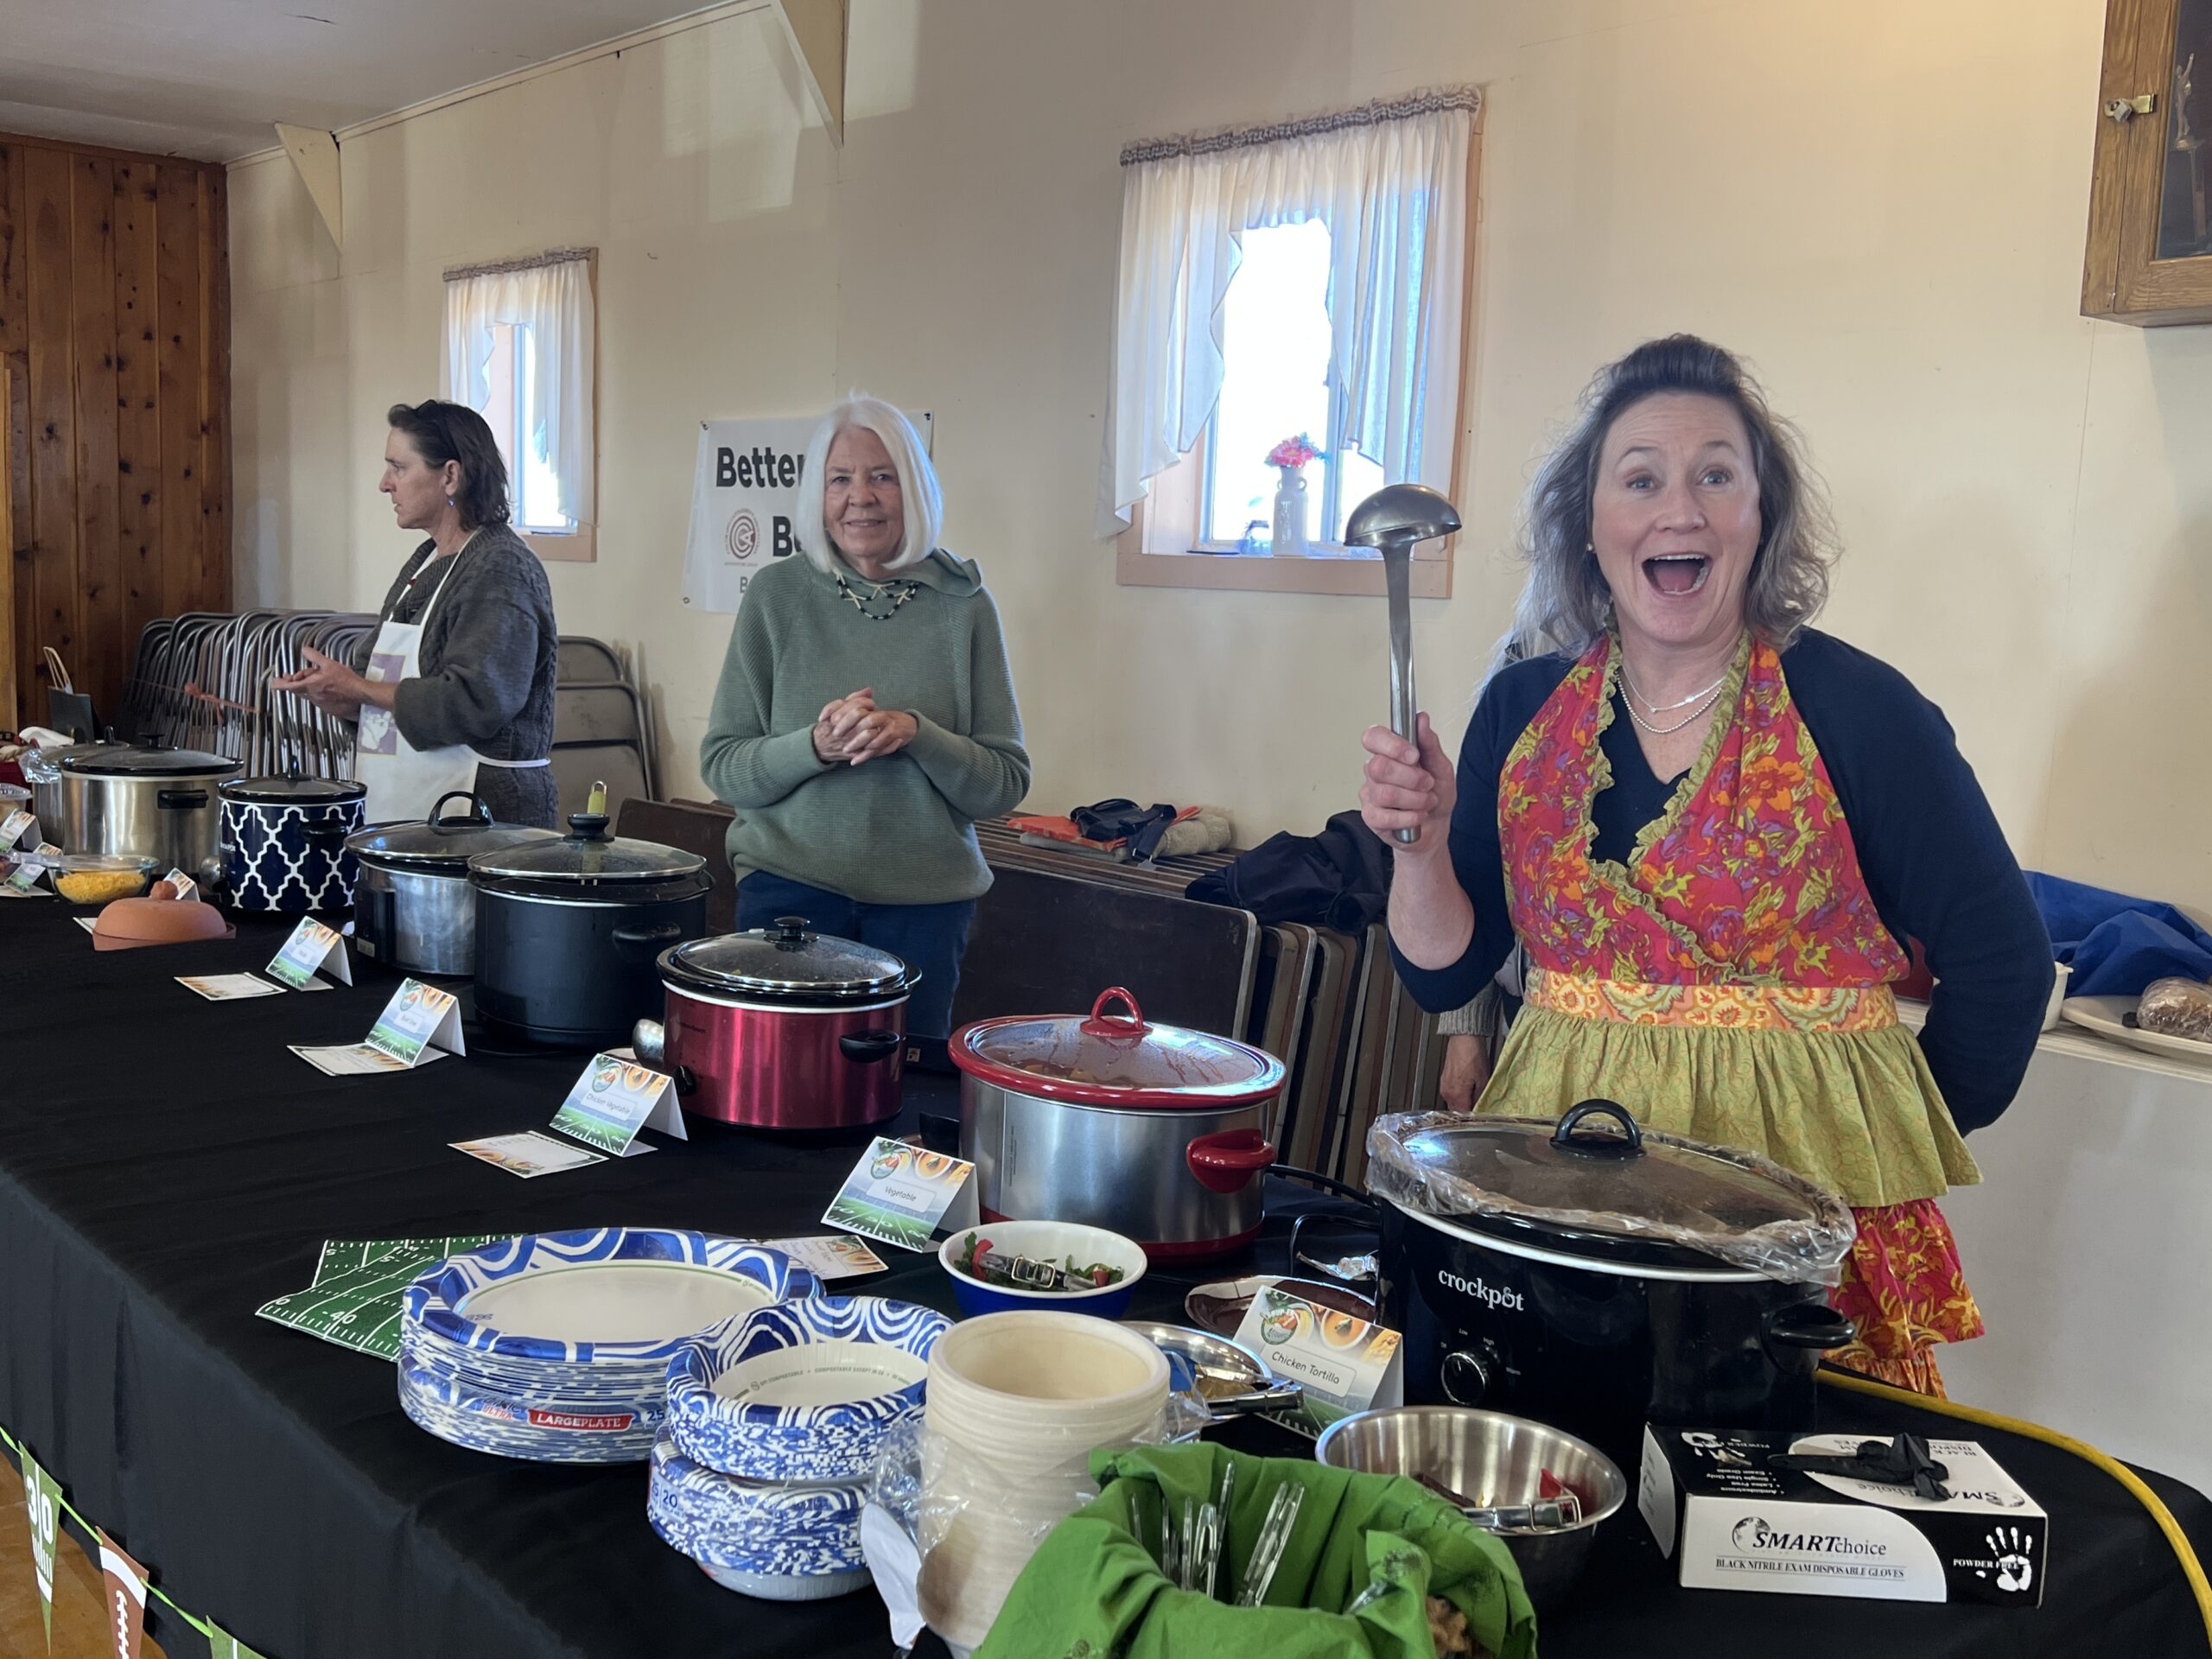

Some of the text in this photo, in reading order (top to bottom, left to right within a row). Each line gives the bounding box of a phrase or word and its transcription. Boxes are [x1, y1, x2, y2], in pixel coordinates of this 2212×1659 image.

[885, 1185, 917, 1202] Vegetable
[1272, 1351, 1306, 1372] Chicken
[483, 1405, 513, 1420] ULTRA
[646, 1409, 665, 1421] 25
[662, 1489, 678, 1509] 20
[1716, 1559, 1905, 1578] BLACK NITRILE EXAM DISPOSABLE GLOVES
[1953, 1558, 1993, 1568] POWDER
